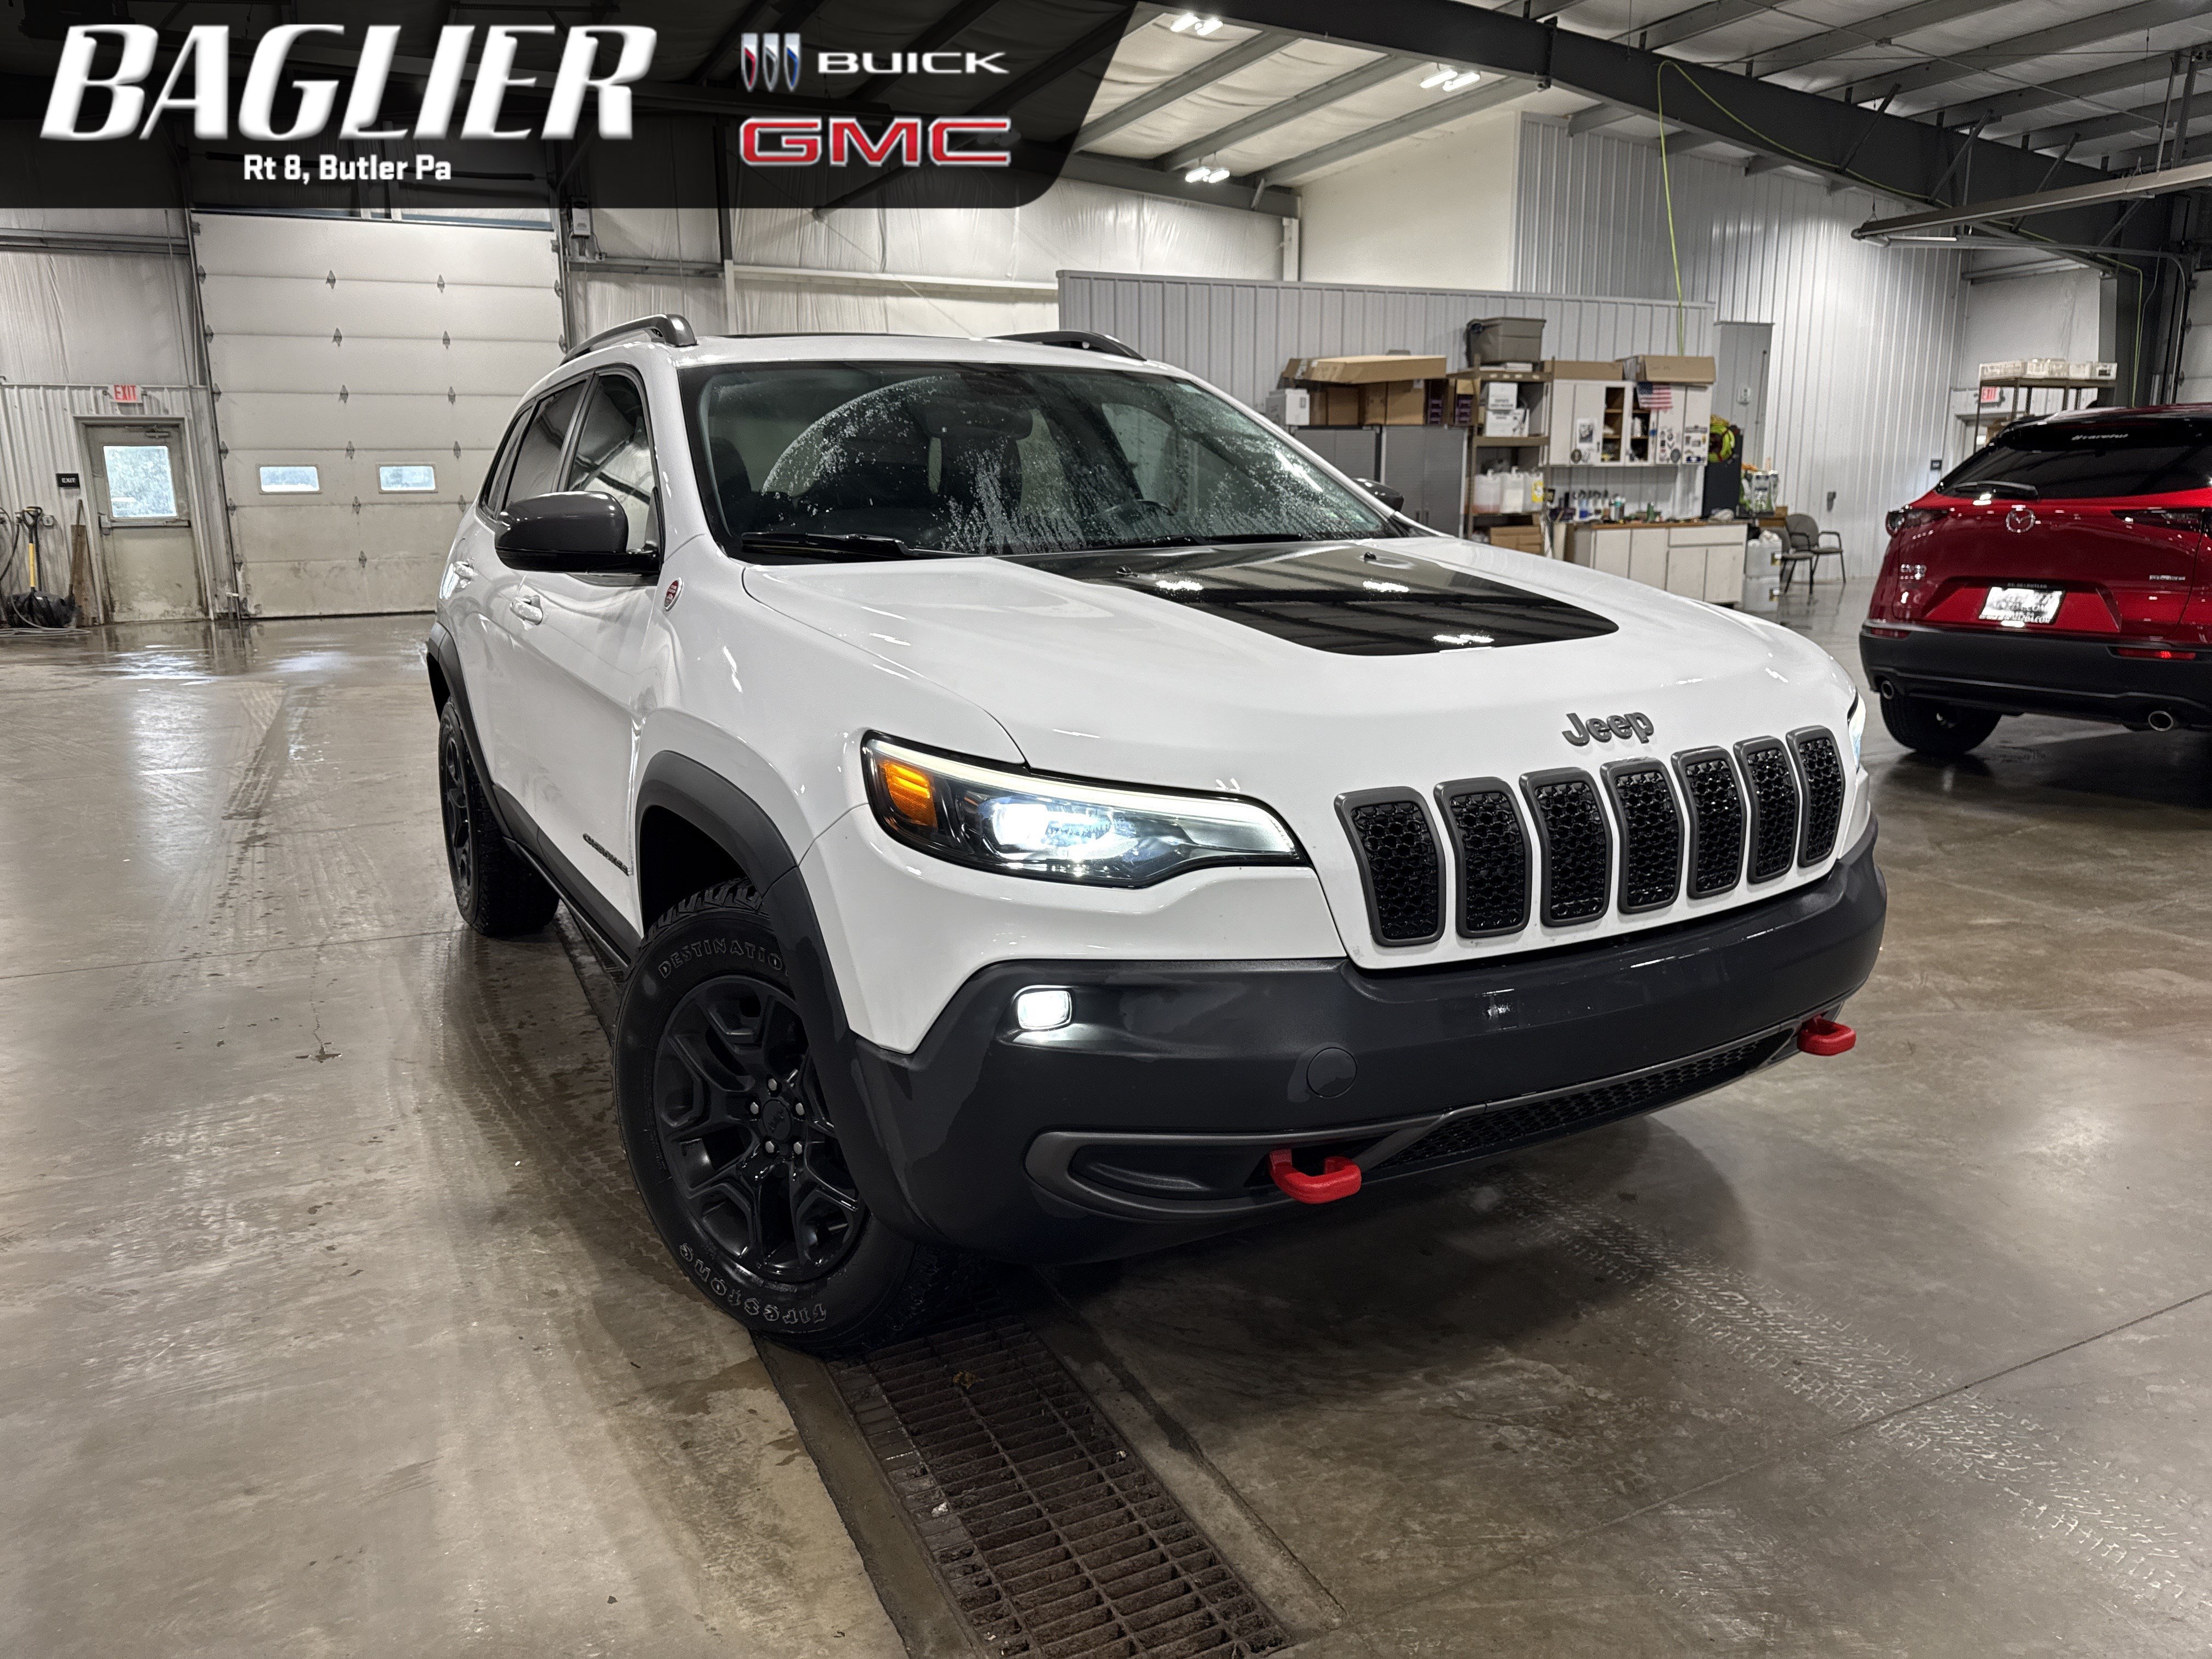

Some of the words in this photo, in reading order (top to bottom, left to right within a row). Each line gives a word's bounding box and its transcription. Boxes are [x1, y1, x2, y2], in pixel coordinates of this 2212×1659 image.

[114, 385, 138, 402] EXIT
[1562, 712, 1655, 747] Jeep
[658, 938, 788, 979] DESTINATIO
